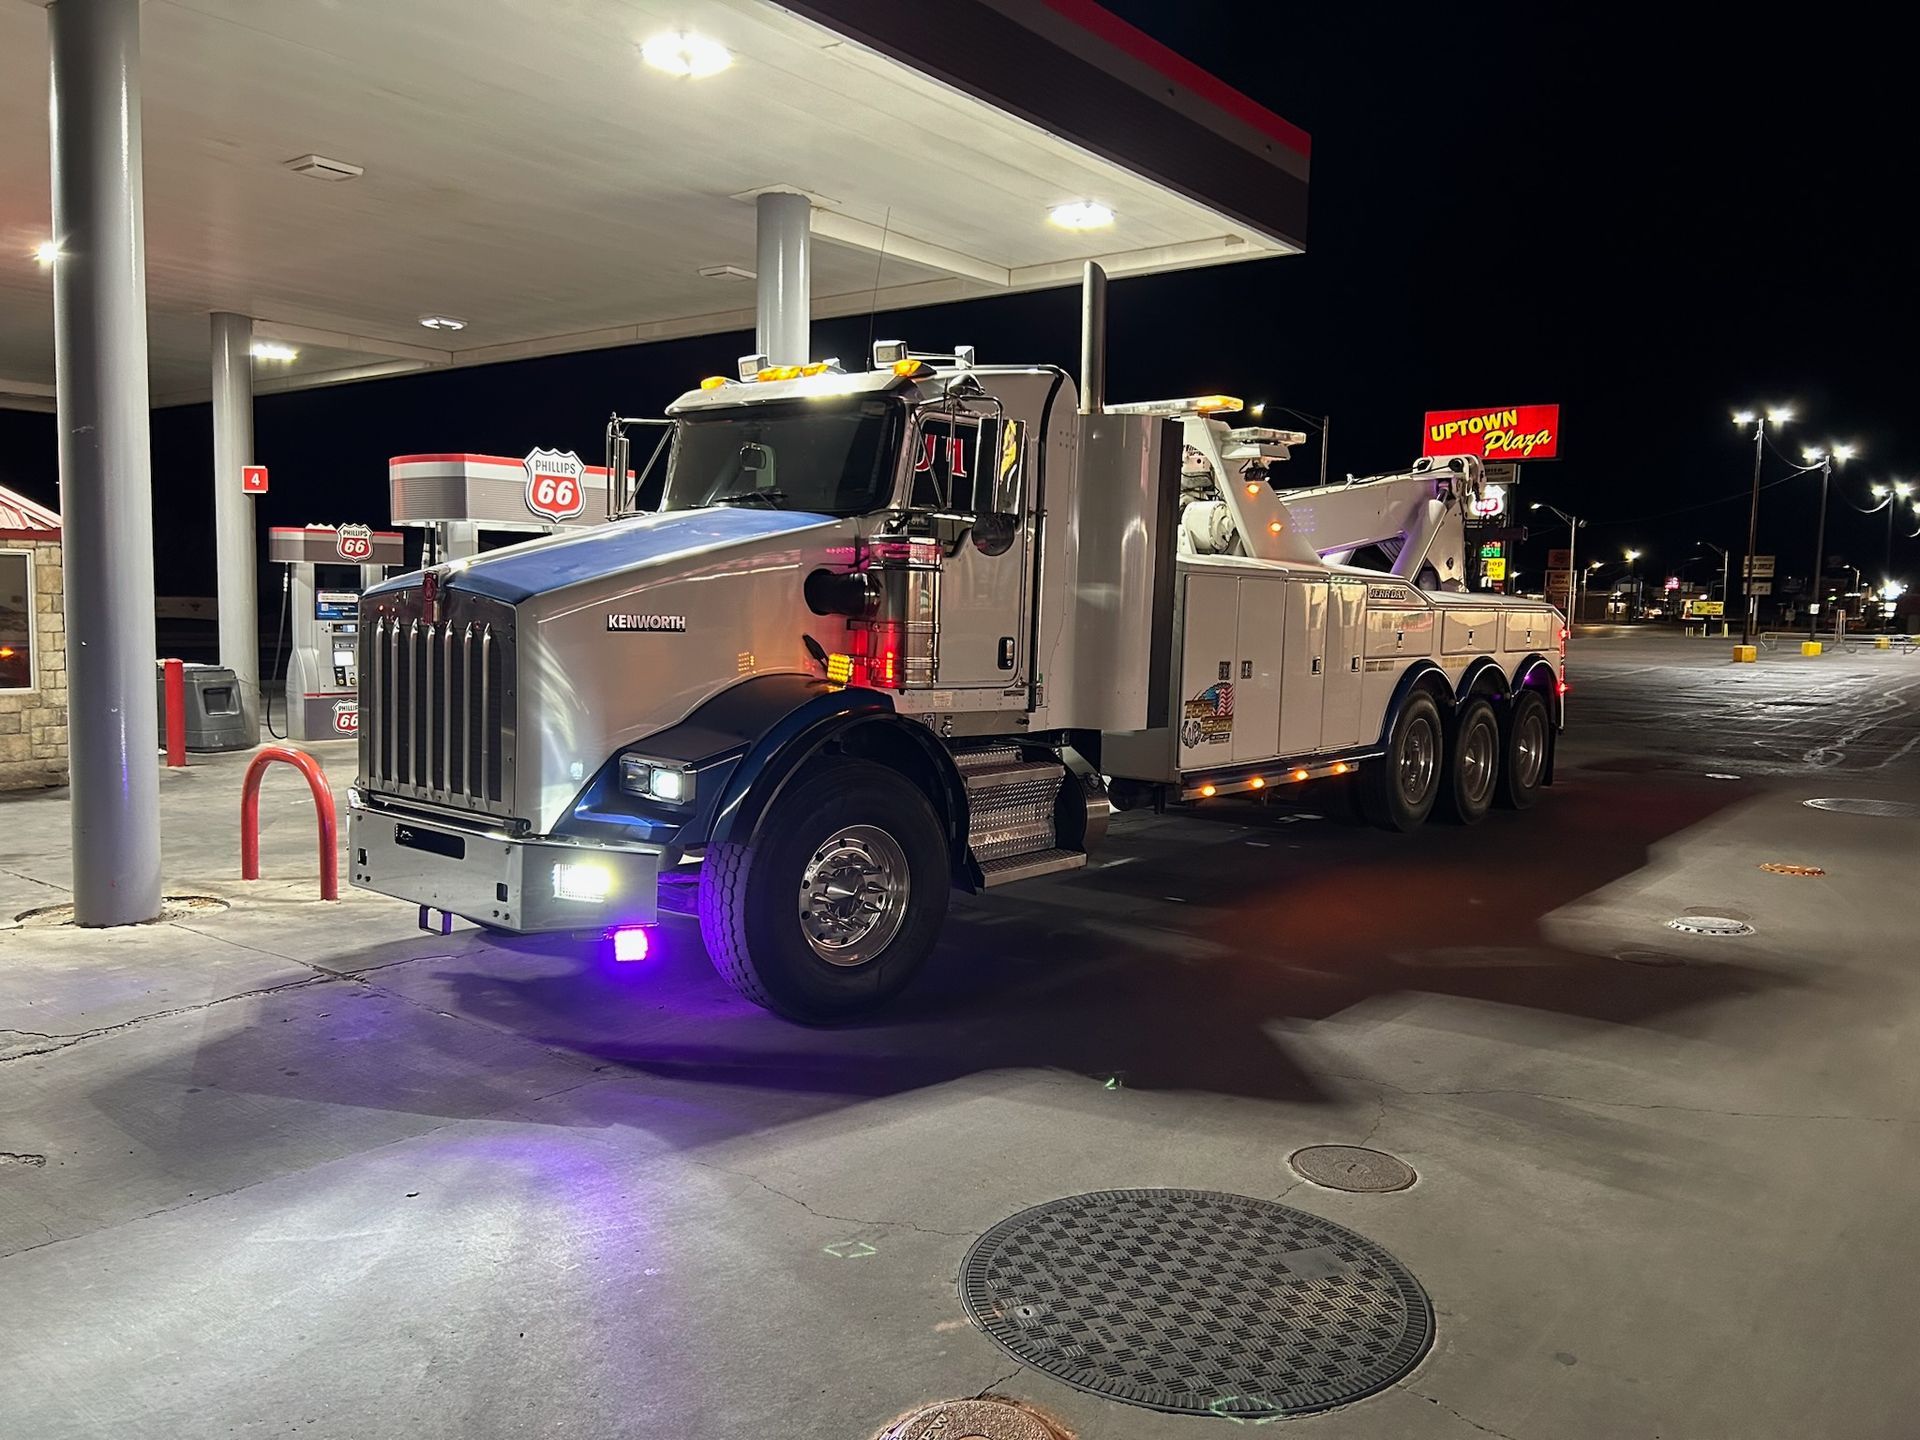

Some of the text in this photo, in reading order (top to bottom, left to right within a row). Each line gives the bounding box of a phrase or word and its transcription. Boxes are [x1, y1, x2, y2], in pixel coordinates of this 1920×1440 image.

[1431, 409, 1518, 442] UPTOWN
[1483, 429, 1552, 457] Plaza
[535, 460, 576, 475] PHILLIPS
[251, 472, 261, 486] 4
[537, 478, 575, 506] 66
[343, 529, 368, 537] PHILLIPS
[344, 539, 367, 554] 66
[608, 614, 686, 629] KENWORTH
[338, 704, 358, 712] PHILLIP
[340, 714, 359, 728] 66
